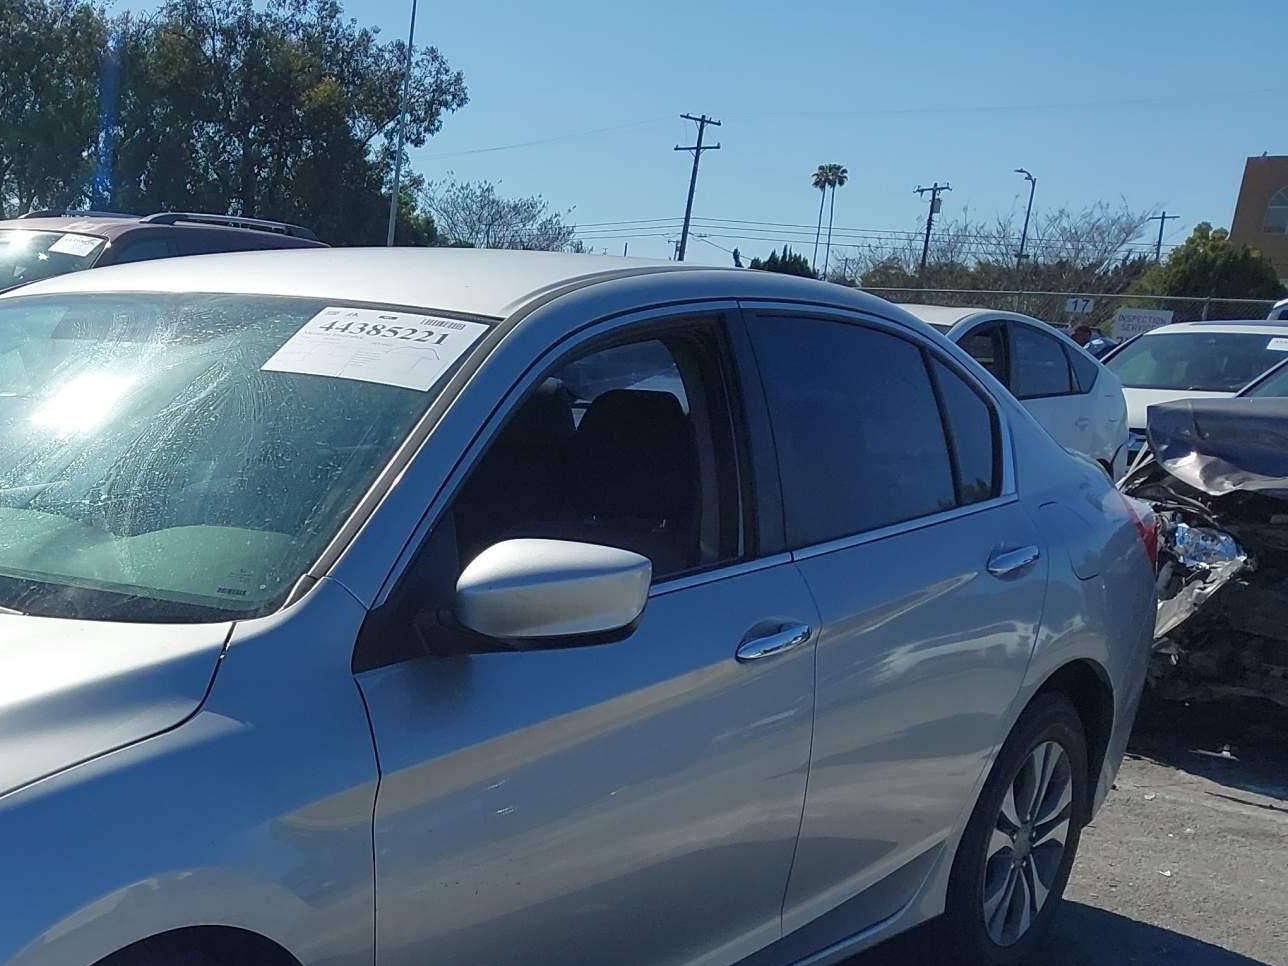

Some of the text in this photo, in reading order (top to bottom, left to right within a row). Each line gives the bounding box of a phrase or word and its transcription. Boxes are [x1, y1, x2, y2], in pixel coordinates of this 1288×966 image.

[1072, 299, 1090, 312] 17
[1118, 313, 1167, 325] INSPECTION
[319, 320, 450, 345] 44385221
